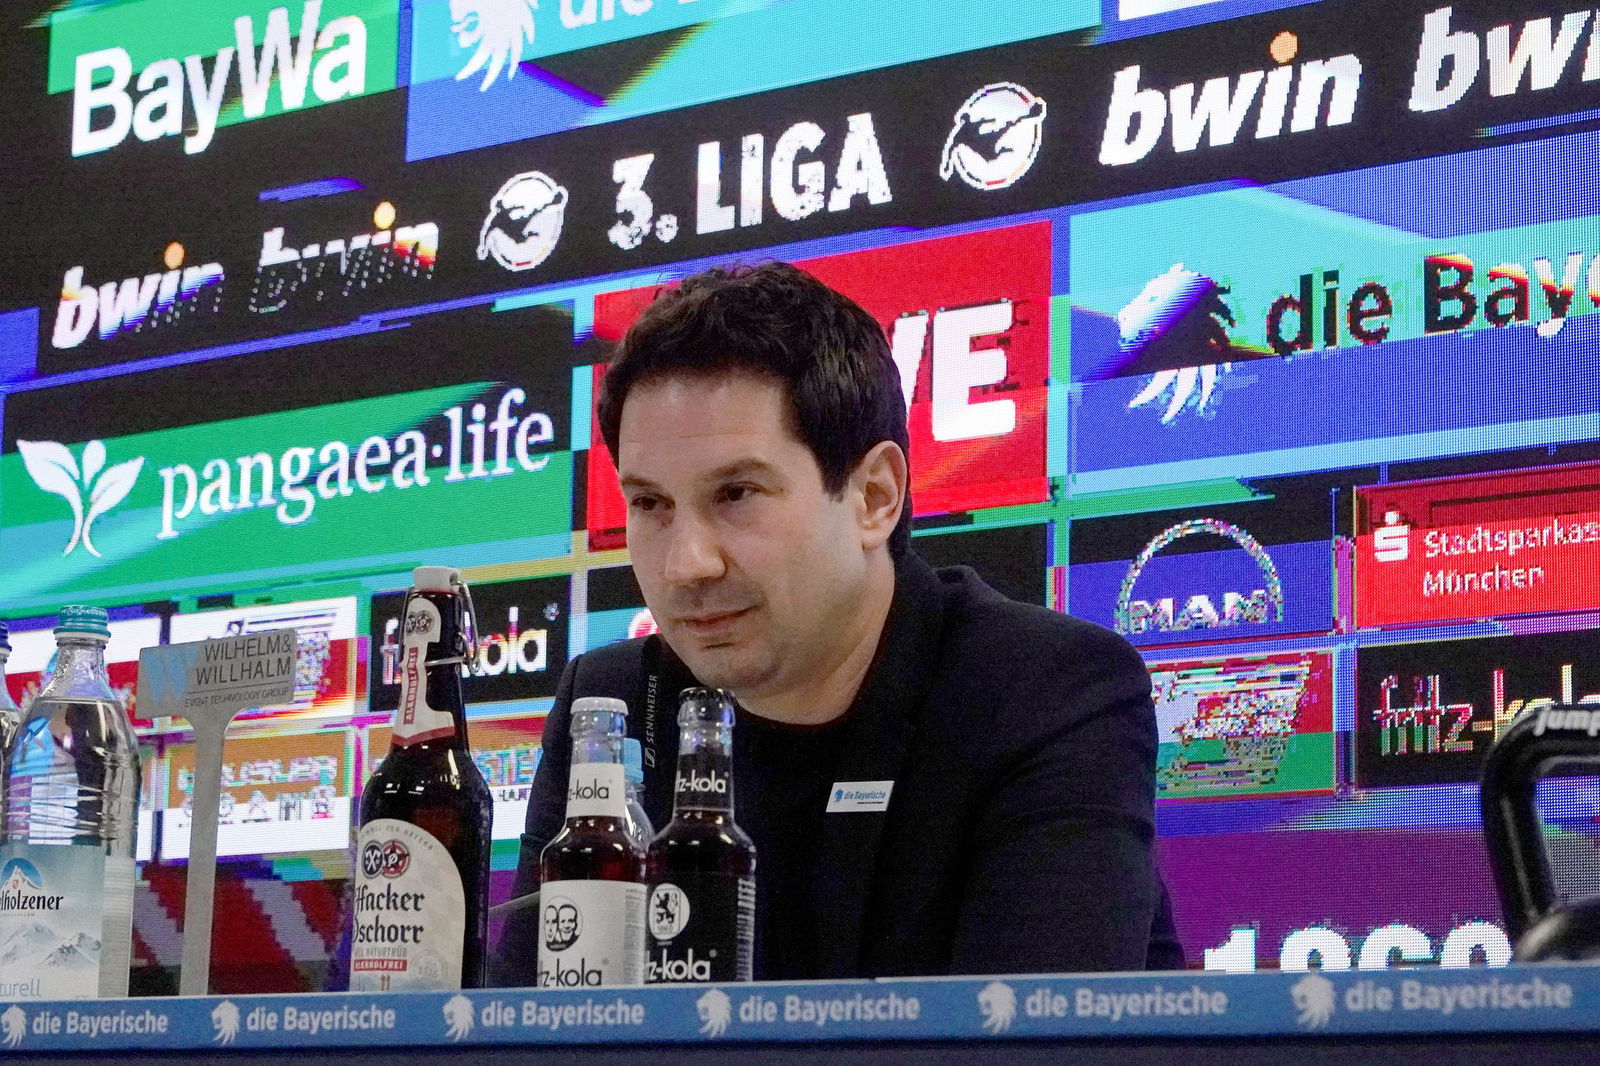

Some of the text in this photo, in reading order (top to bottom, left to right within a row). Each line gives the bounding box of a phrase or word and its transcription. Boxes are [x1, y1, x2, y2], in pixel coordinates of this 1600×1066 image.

[71, 0, 367, 157] BayWa
[1099, 31, 1363, 166] bwin
[608, 112, 892, 250] 3. LIGA
[51, 241, 224, 349] bwin
[1267, 270, 1392, 357] die
[1129, 589, 1269, 635] MAN
[195, 656, 291, 686] WILLHALM
[261, 687, 289, 699] GROUP
[646, 675, 659, 743] SENNHEISER
[481, 999, 646, 1030] die Bayerische
[739, 993, 920, 1027] die Bayerische
[1025, 985, 1229, 1022] die Bayerische
[1345, 977, 1573, 1015] die Bayerische
[32, 1010, 169, 1035] die Bayerische
[246, 1005, 396, 1034] die Bayerische
